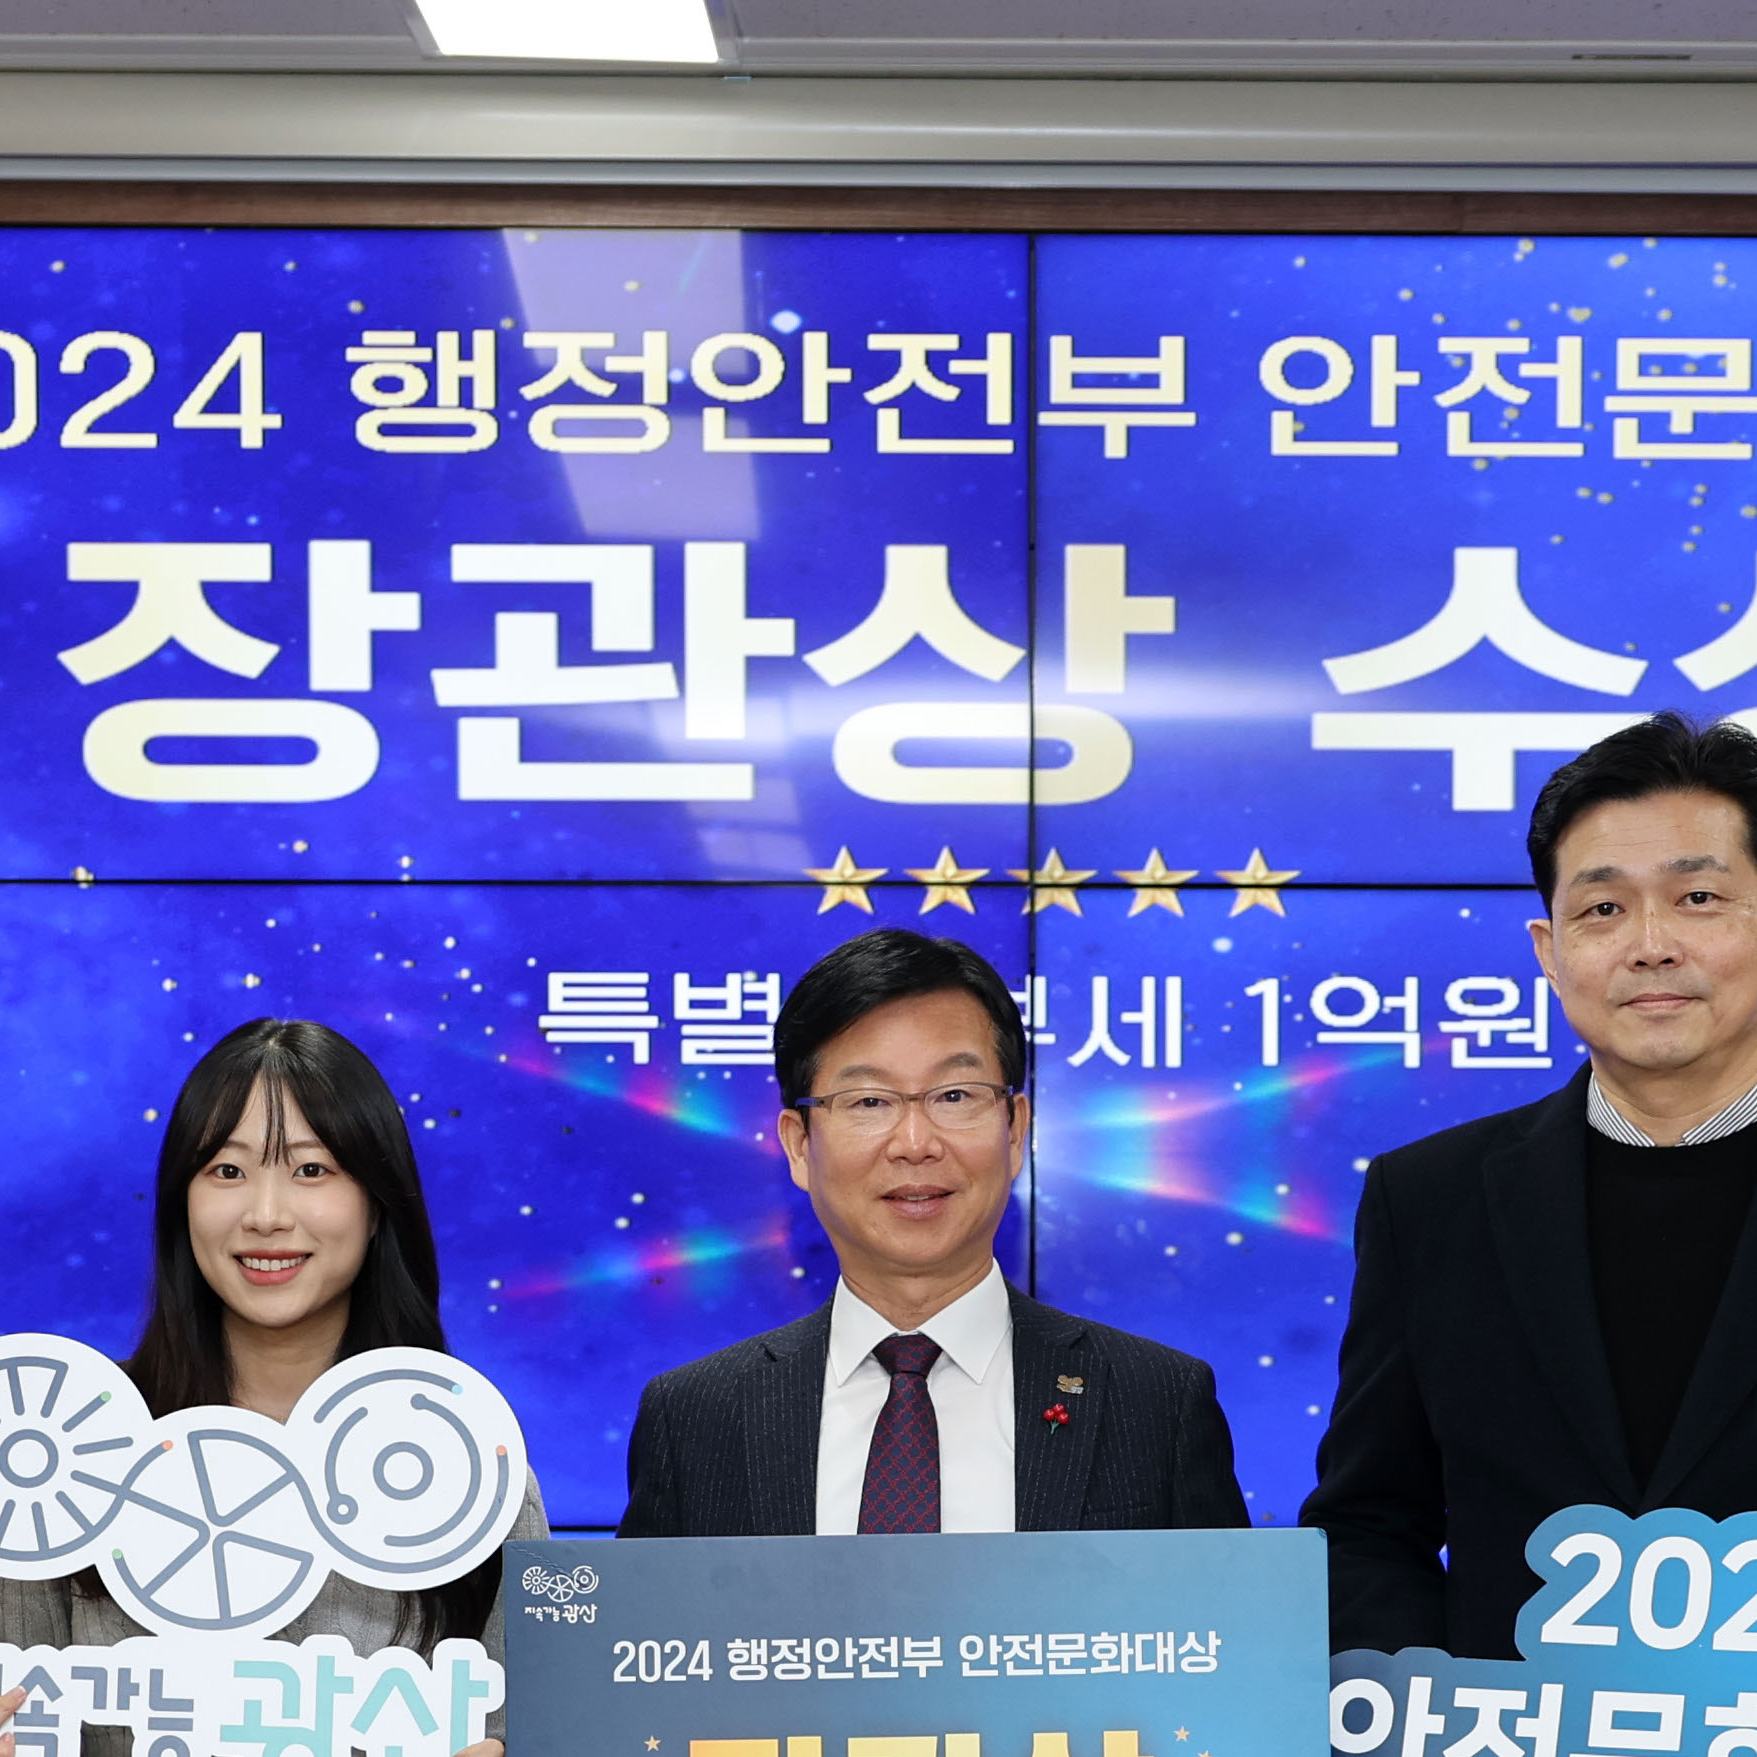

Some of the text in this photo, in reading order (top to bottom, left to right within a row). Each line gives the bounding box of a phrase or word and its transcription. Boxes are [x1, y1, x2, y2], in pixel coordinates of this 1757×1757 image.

[345, 329, 1197, 459] 행정안전부
[56, 539, 1176, 806] 장관상
[538, 972, 1553, 1069] 특별세 1억원
[524, 1603, 598, 1624] 지속가능 광산
[613, 1630, 1222, 1683] 2024 행정안전부 안전문화대상
